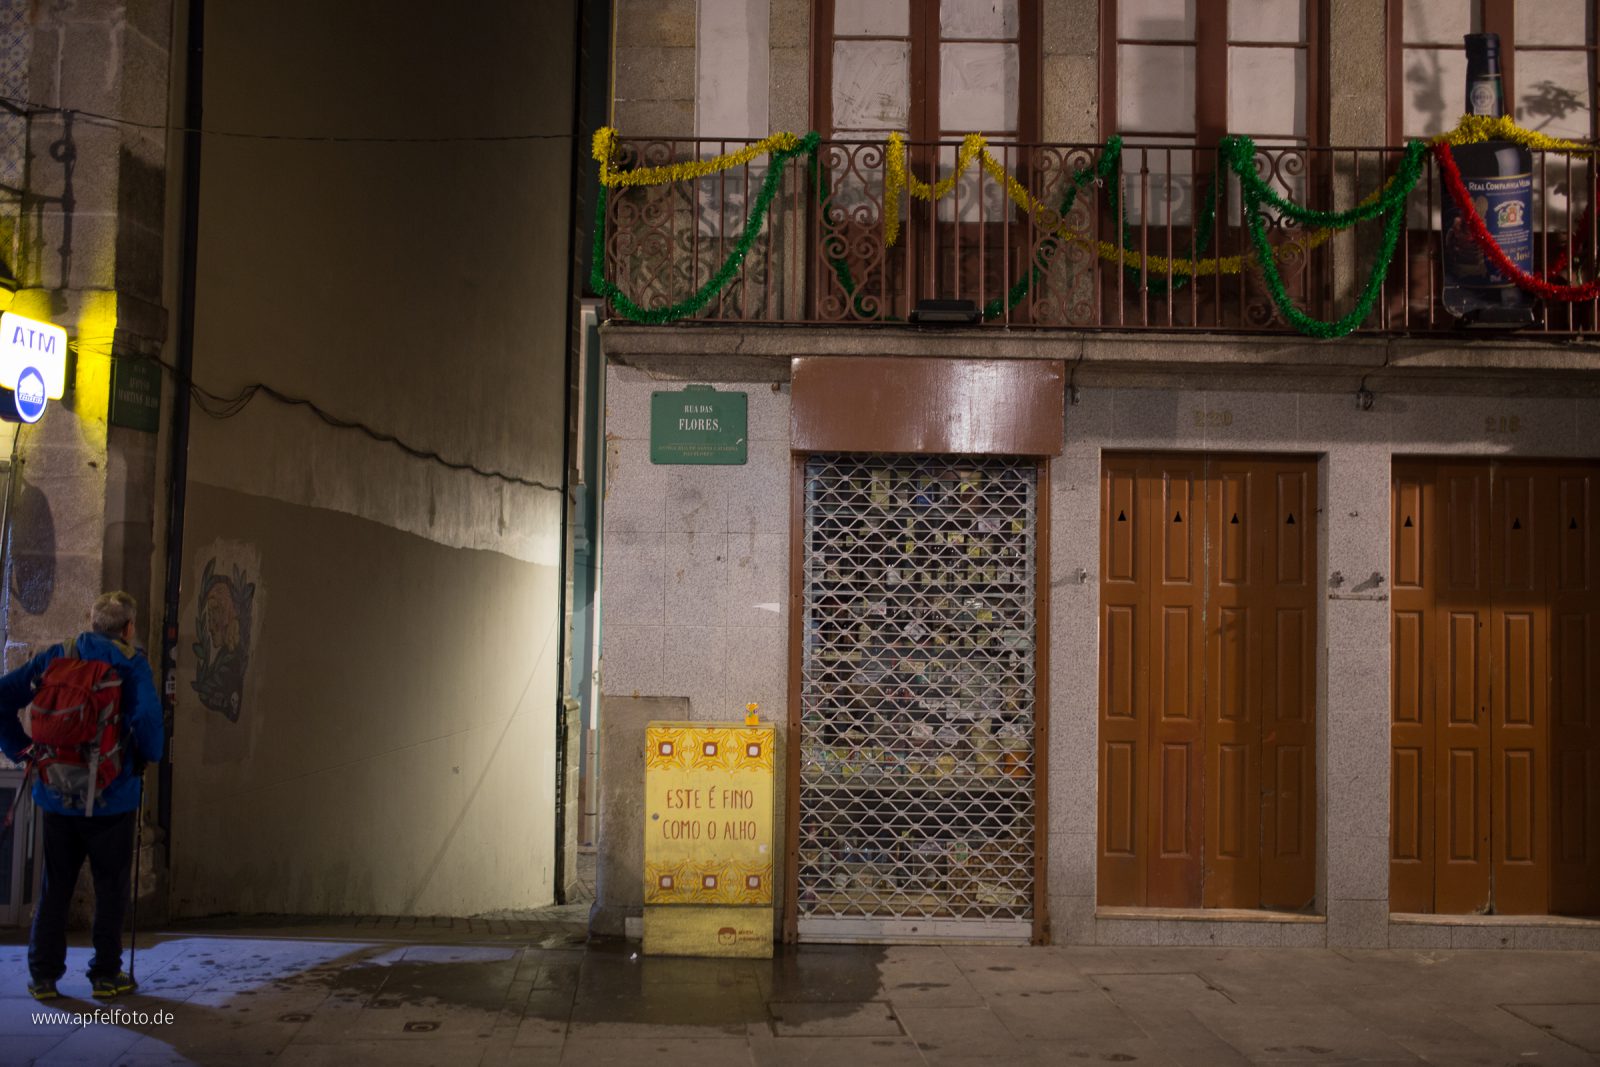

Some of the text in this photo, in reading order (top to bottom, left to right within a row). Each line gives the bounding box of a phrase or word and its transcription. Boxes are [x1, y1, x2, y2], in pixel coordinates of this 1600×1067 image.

[12, 326, 56, 355] ATM
[684, 405, 713, 413] RUA DAS
[679, 418, 719, 431] FLORES
[667, 785, 753, 809] ESTE É FINO
[663, 819, 757, 840] COMO O ALHO
